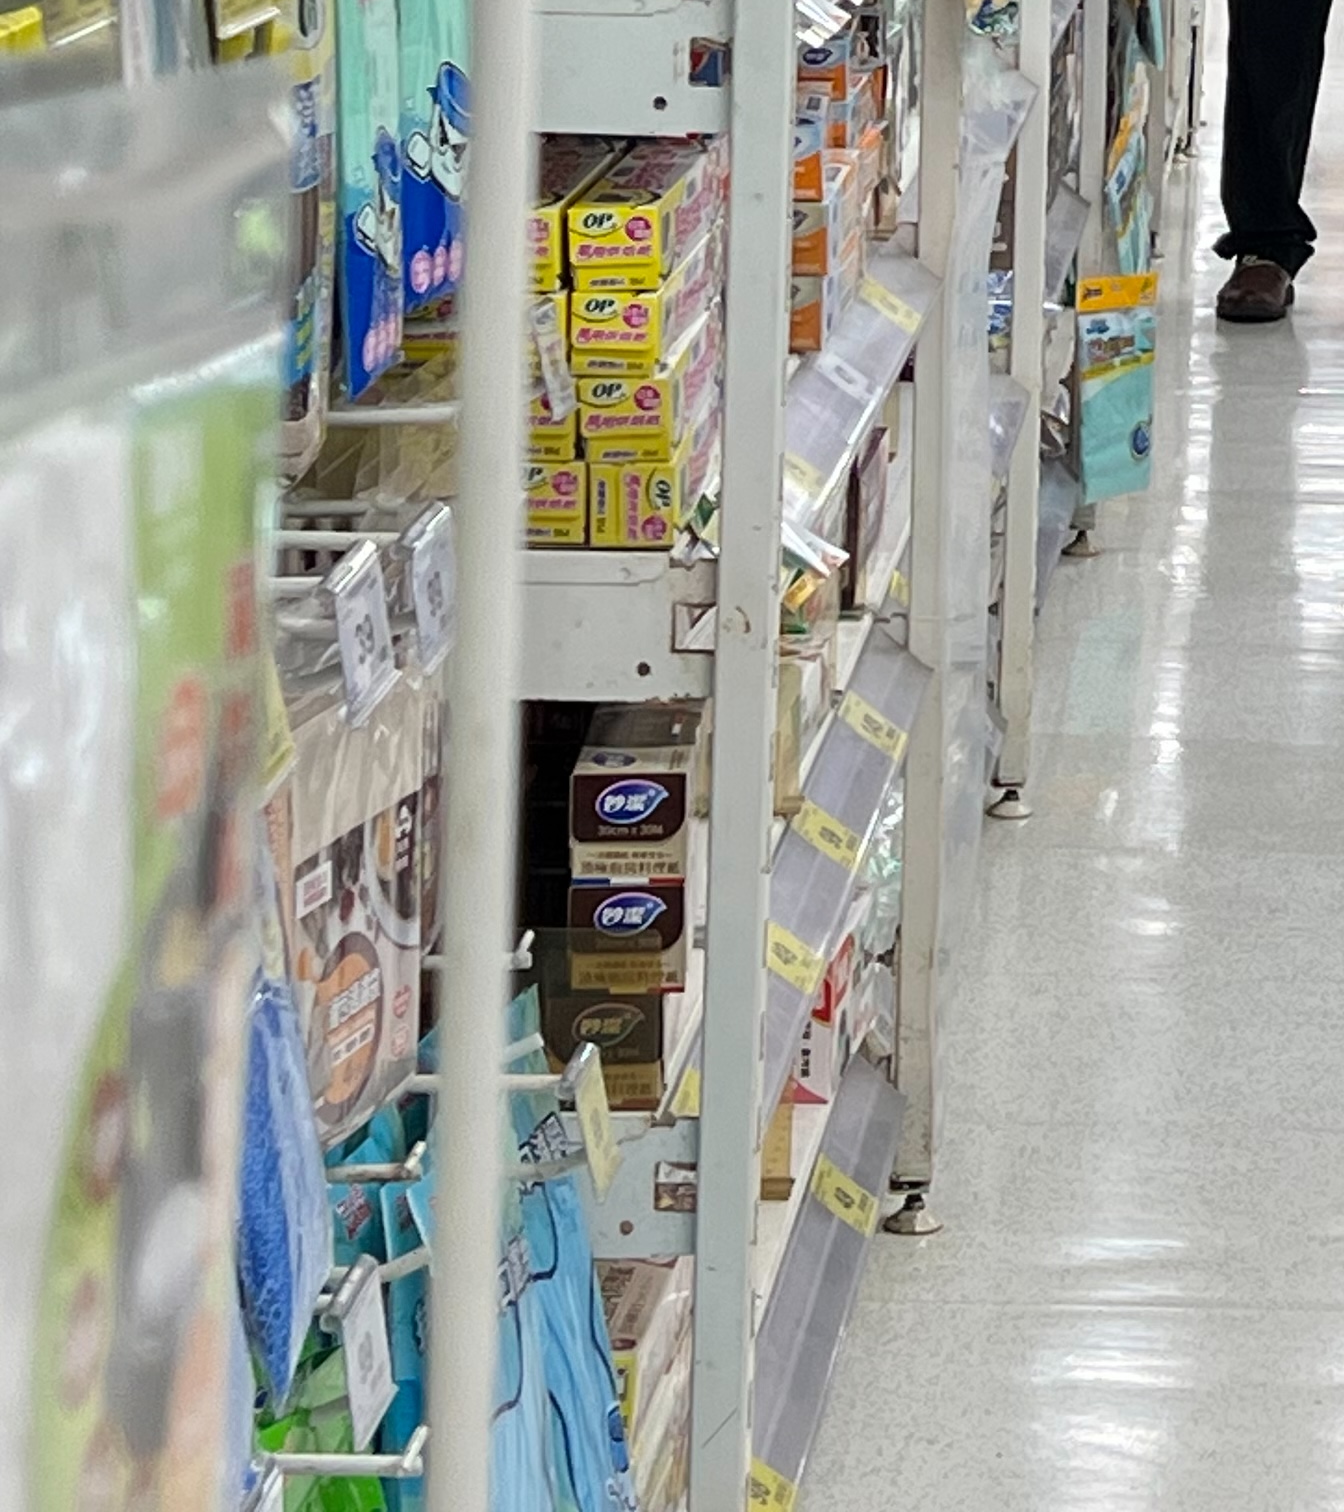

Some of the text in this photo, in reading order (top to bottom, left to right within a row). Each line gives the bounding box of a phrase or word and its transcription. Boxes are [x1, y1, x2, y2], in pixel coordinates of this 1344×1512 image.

[583, 212, 613, 229] OP
[585, 298, 615, 313] OP
[591, 383, 622, 398] OP
[601, 906, 645, 926] 妙潔
